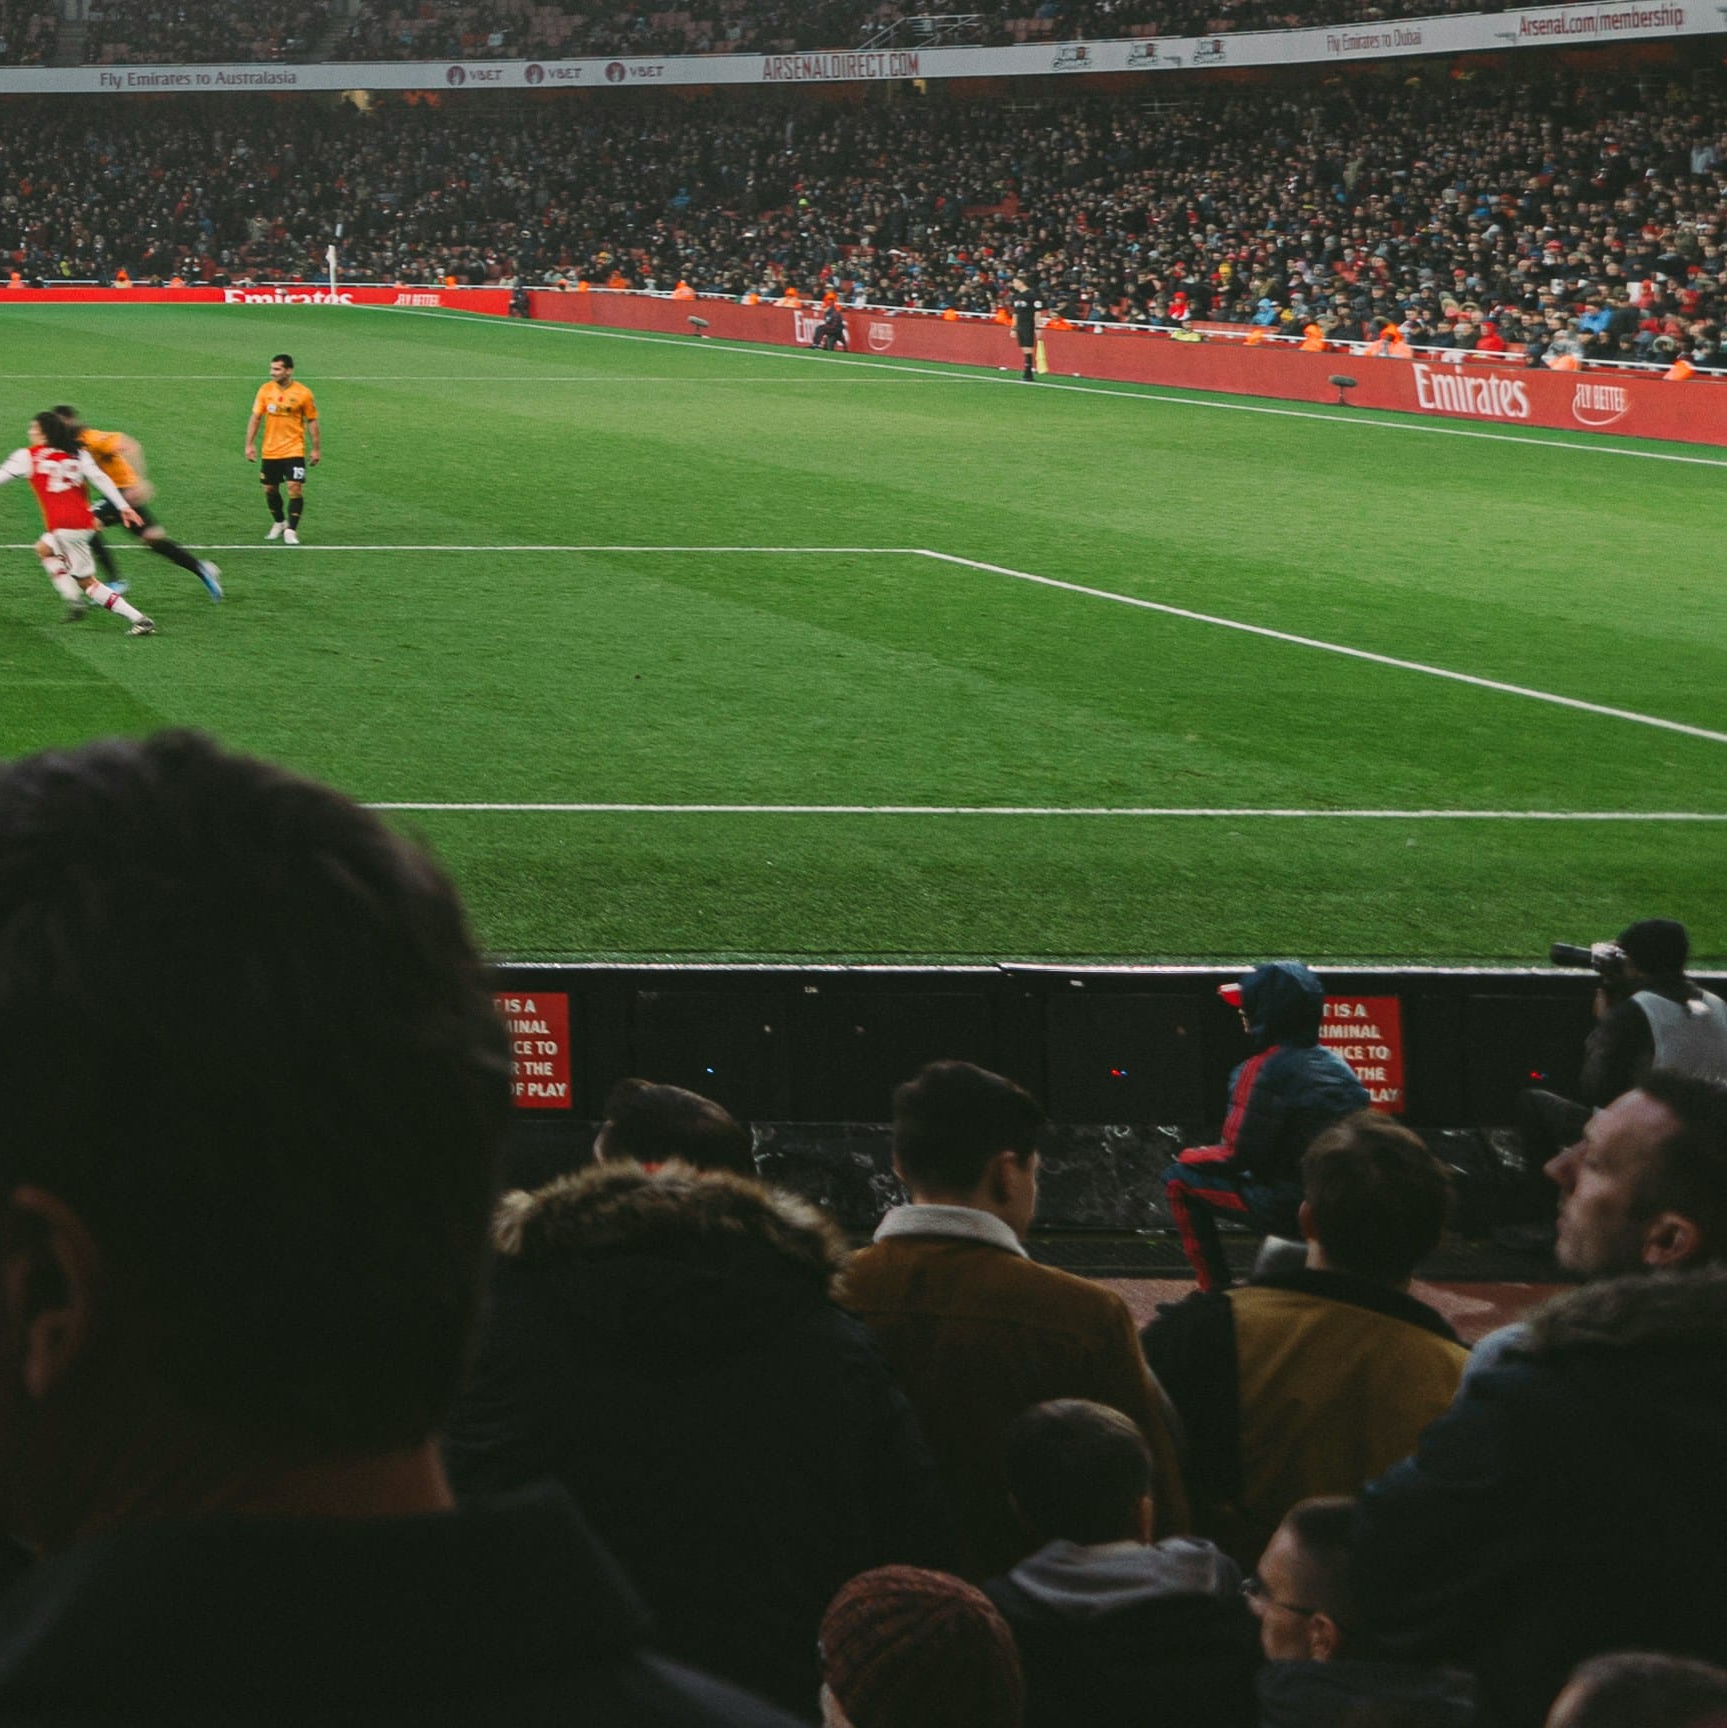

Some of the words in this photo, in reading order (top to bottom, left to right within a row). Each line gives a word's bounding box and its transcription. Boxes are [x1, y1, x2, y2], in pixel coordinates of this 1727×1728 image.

[1518, 3, 1685, 39] Arsenal.com/membership
[1327, 35, 1340, 55] Fly
[1342, 33, 1380, 51] Emirates
[1381, 33, 1392, 48] to
[1393, 26, 1422, 47] Dubai
[762, 52, 921, 80] ARSENALDIRECT.COM
[100, 72, 123, 89] Fly
[127, 71, 191, 87] Emirates
[195, 72, 212, 86] to
[216, 69, 298, 85] Australasia
[1412, 362, 1531, 419] Emirates
[1575, 383, 1592, 408] FLY
[293, 466, 305, 480] 19
[504, 999, 521, 1013] IS
[524, 999, 537, 1013] A
[1334, 1003, 1353, 1018] IS
[1354, 1003, 1368, 1018] A
[537, 1041, 558, 1055] TO
[1366, 1046, 1391, 1060] TO
[523, 1061, 554, 1076] THE
[1355, 1067, 1387, 1081] THE
[528, 1082, 567, 1097] PLAY
[1369, 1088, 1400, 1102] LAY
